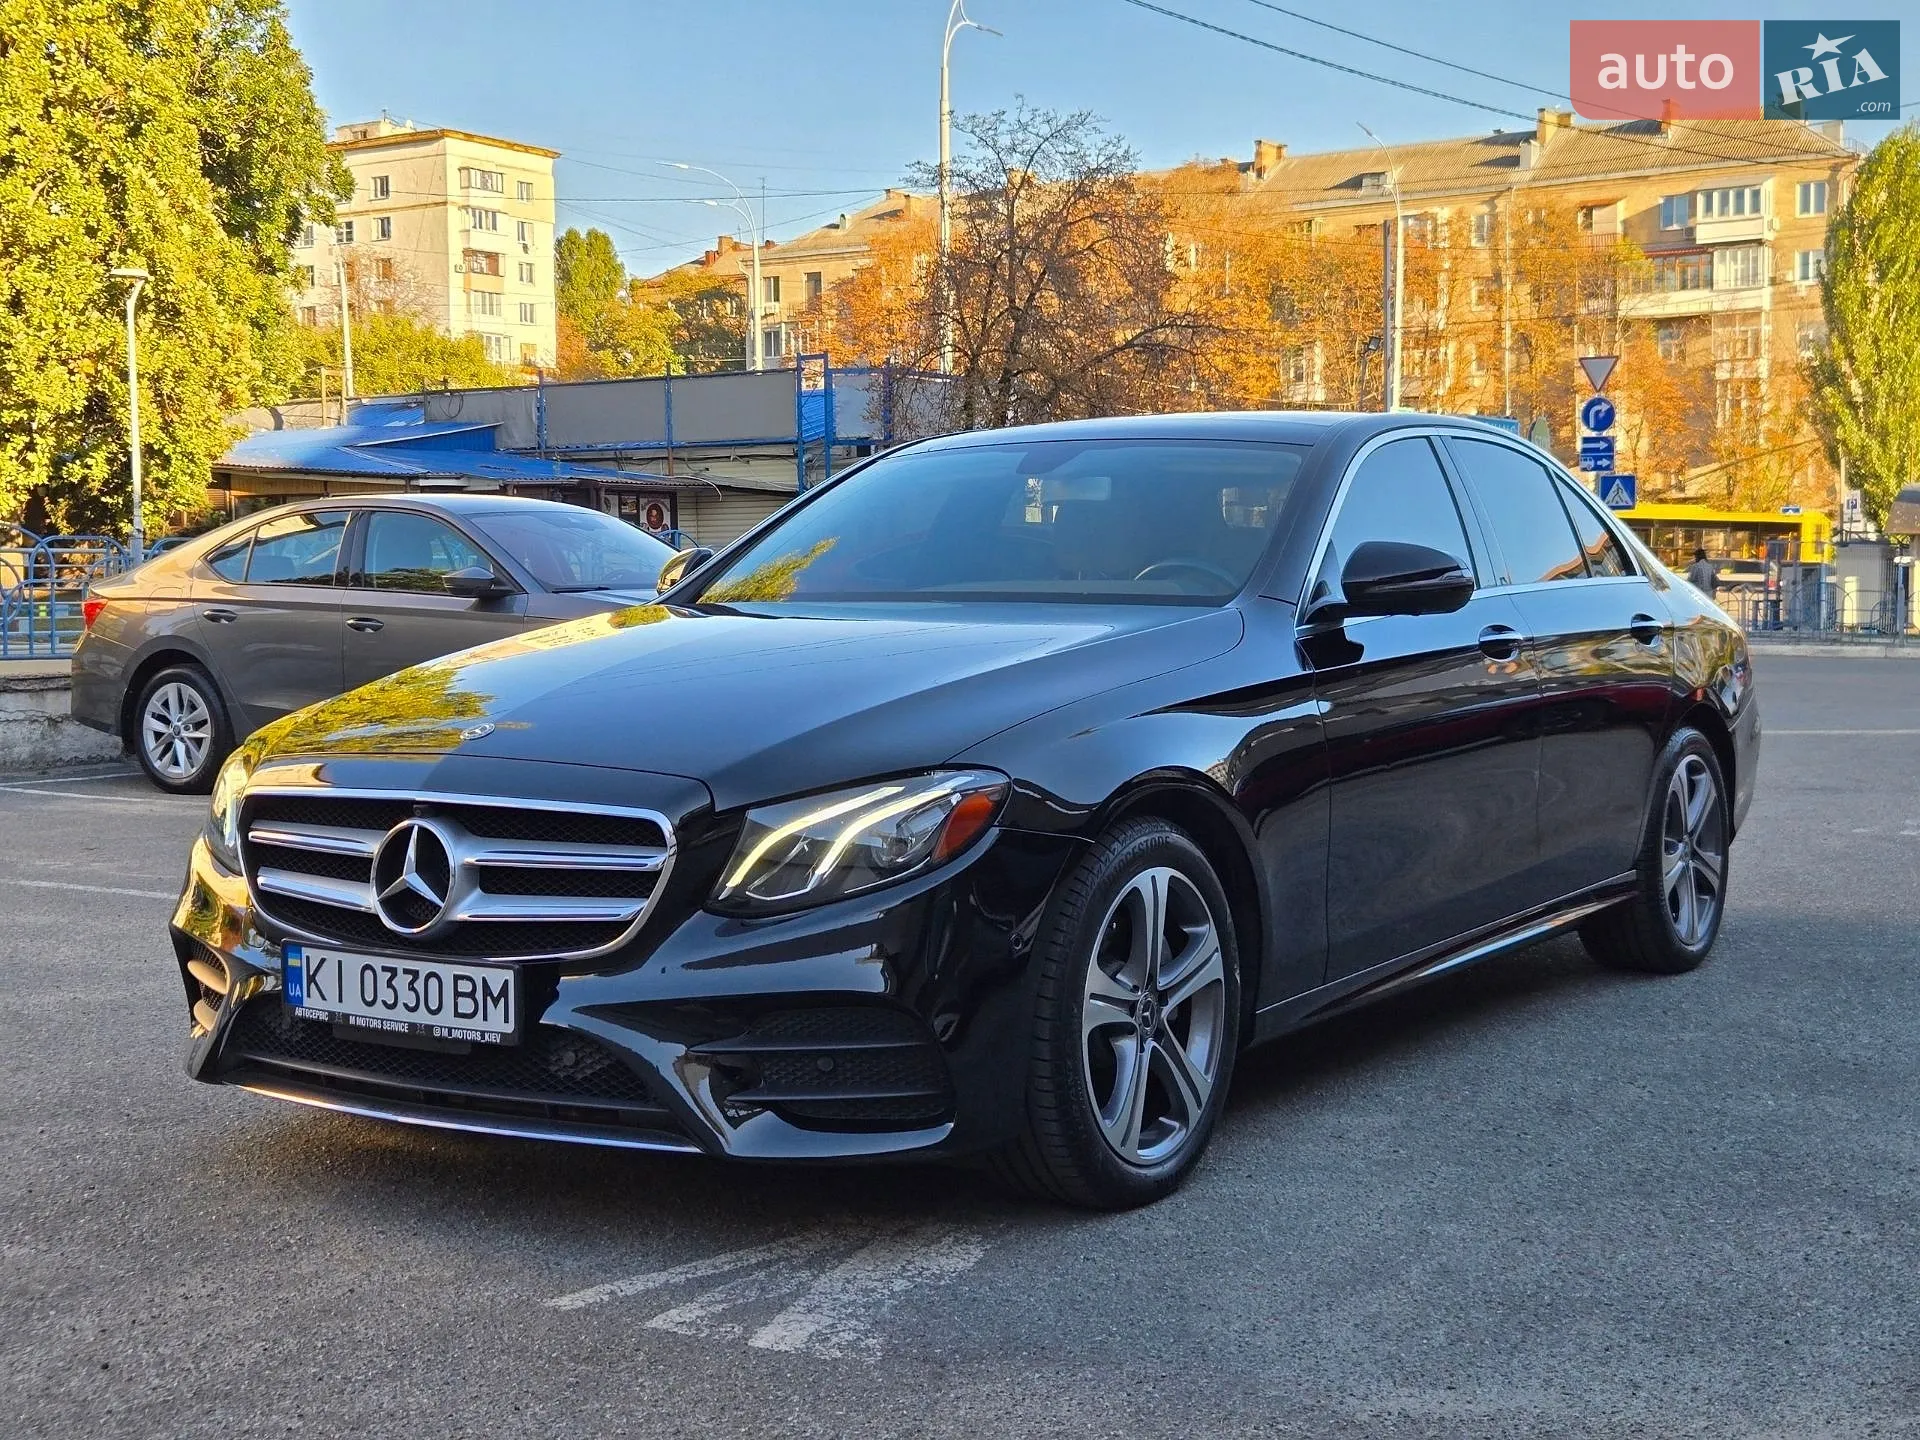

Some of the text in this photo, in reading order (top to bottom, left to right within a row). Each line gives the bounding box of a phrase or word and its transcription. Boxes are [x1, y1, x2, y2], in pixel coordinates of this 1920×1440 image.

[288, 982, 302, 998] UA
[359, 962, 444, 1017] 0330
[452, 972, 510, 1024] BM
[349, 1015, 409, 1033] M MOTORS SERVICE
